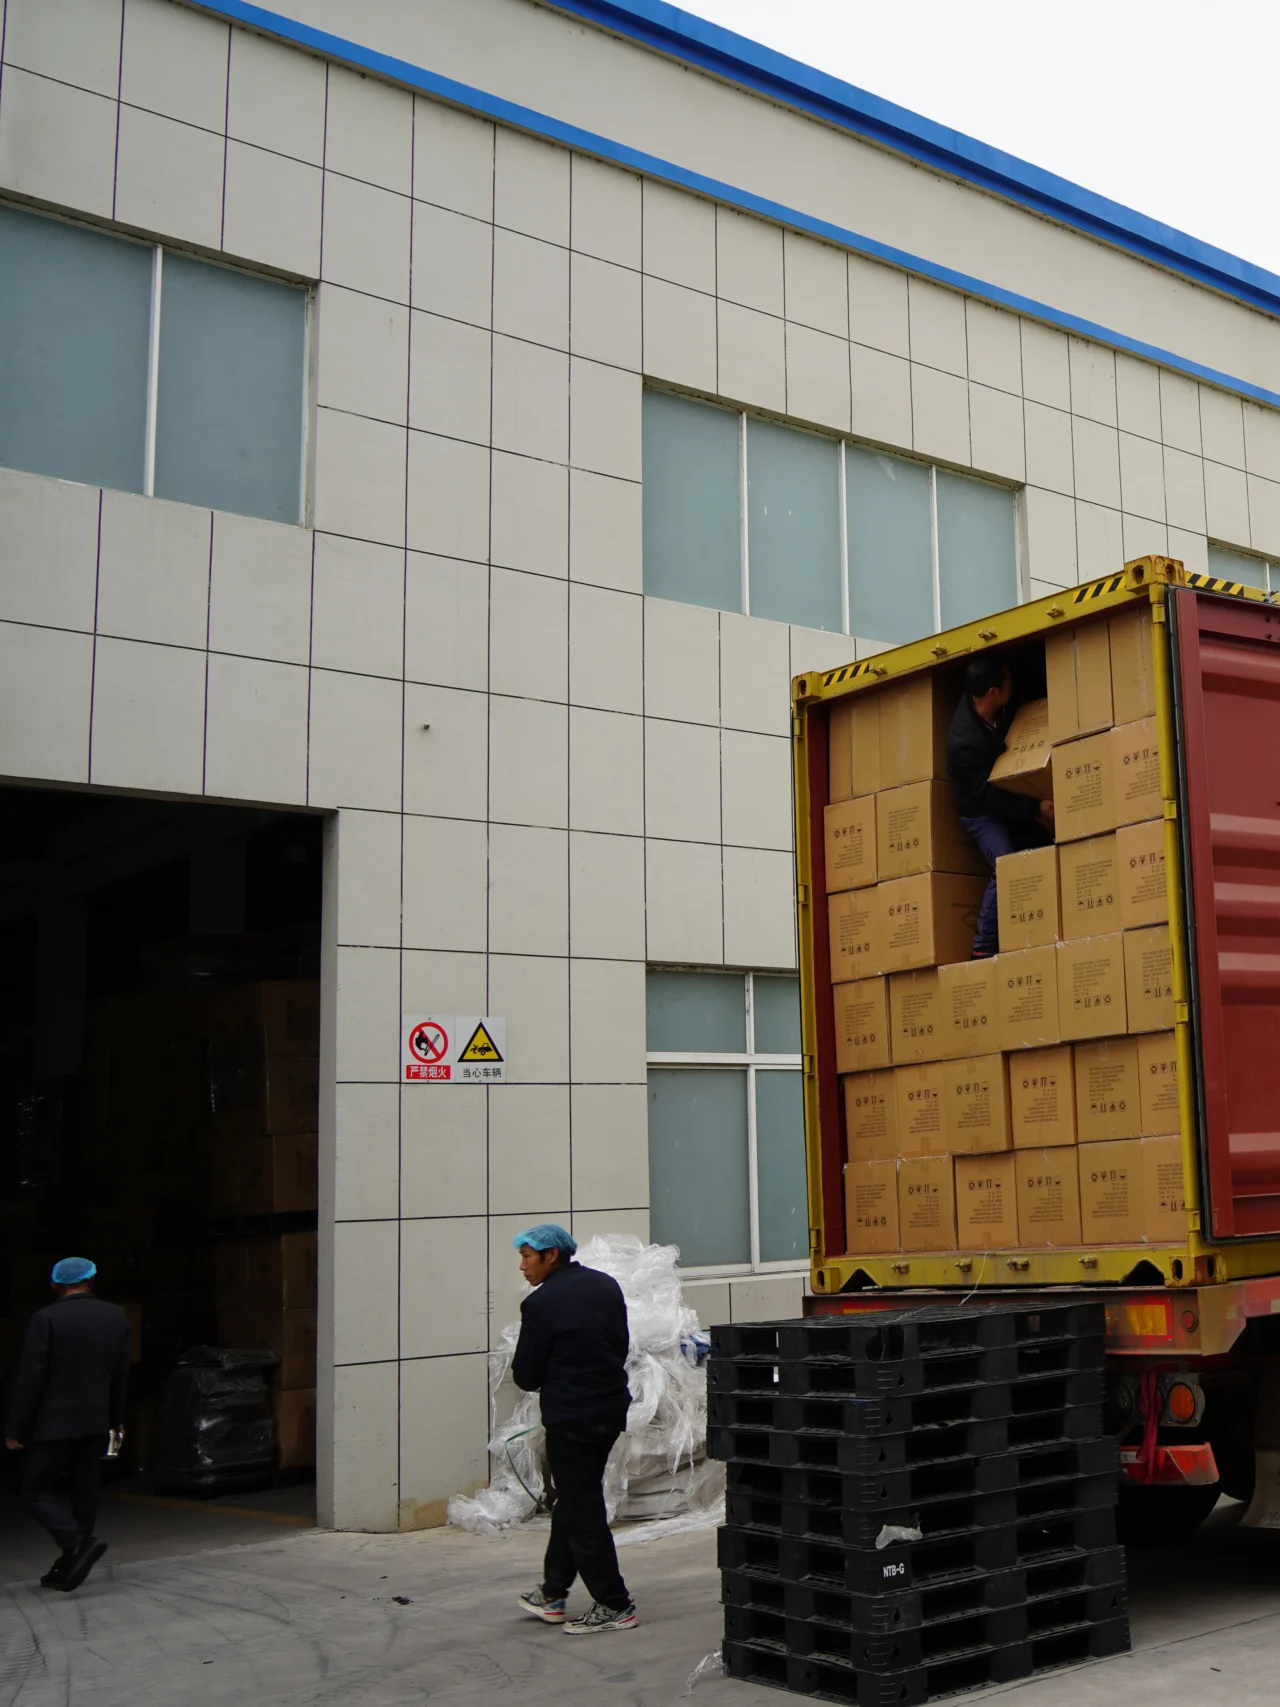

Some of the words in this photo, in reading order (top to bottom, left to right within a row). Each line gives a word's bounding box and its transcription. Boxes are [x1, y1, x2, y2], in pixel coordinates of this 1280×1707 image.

[409, 1065, 447, 1078] 严禁烟火
[462, 1067, 502, 1078] 当心车辆
[883, 1562, 905, 1578] NTB-G
